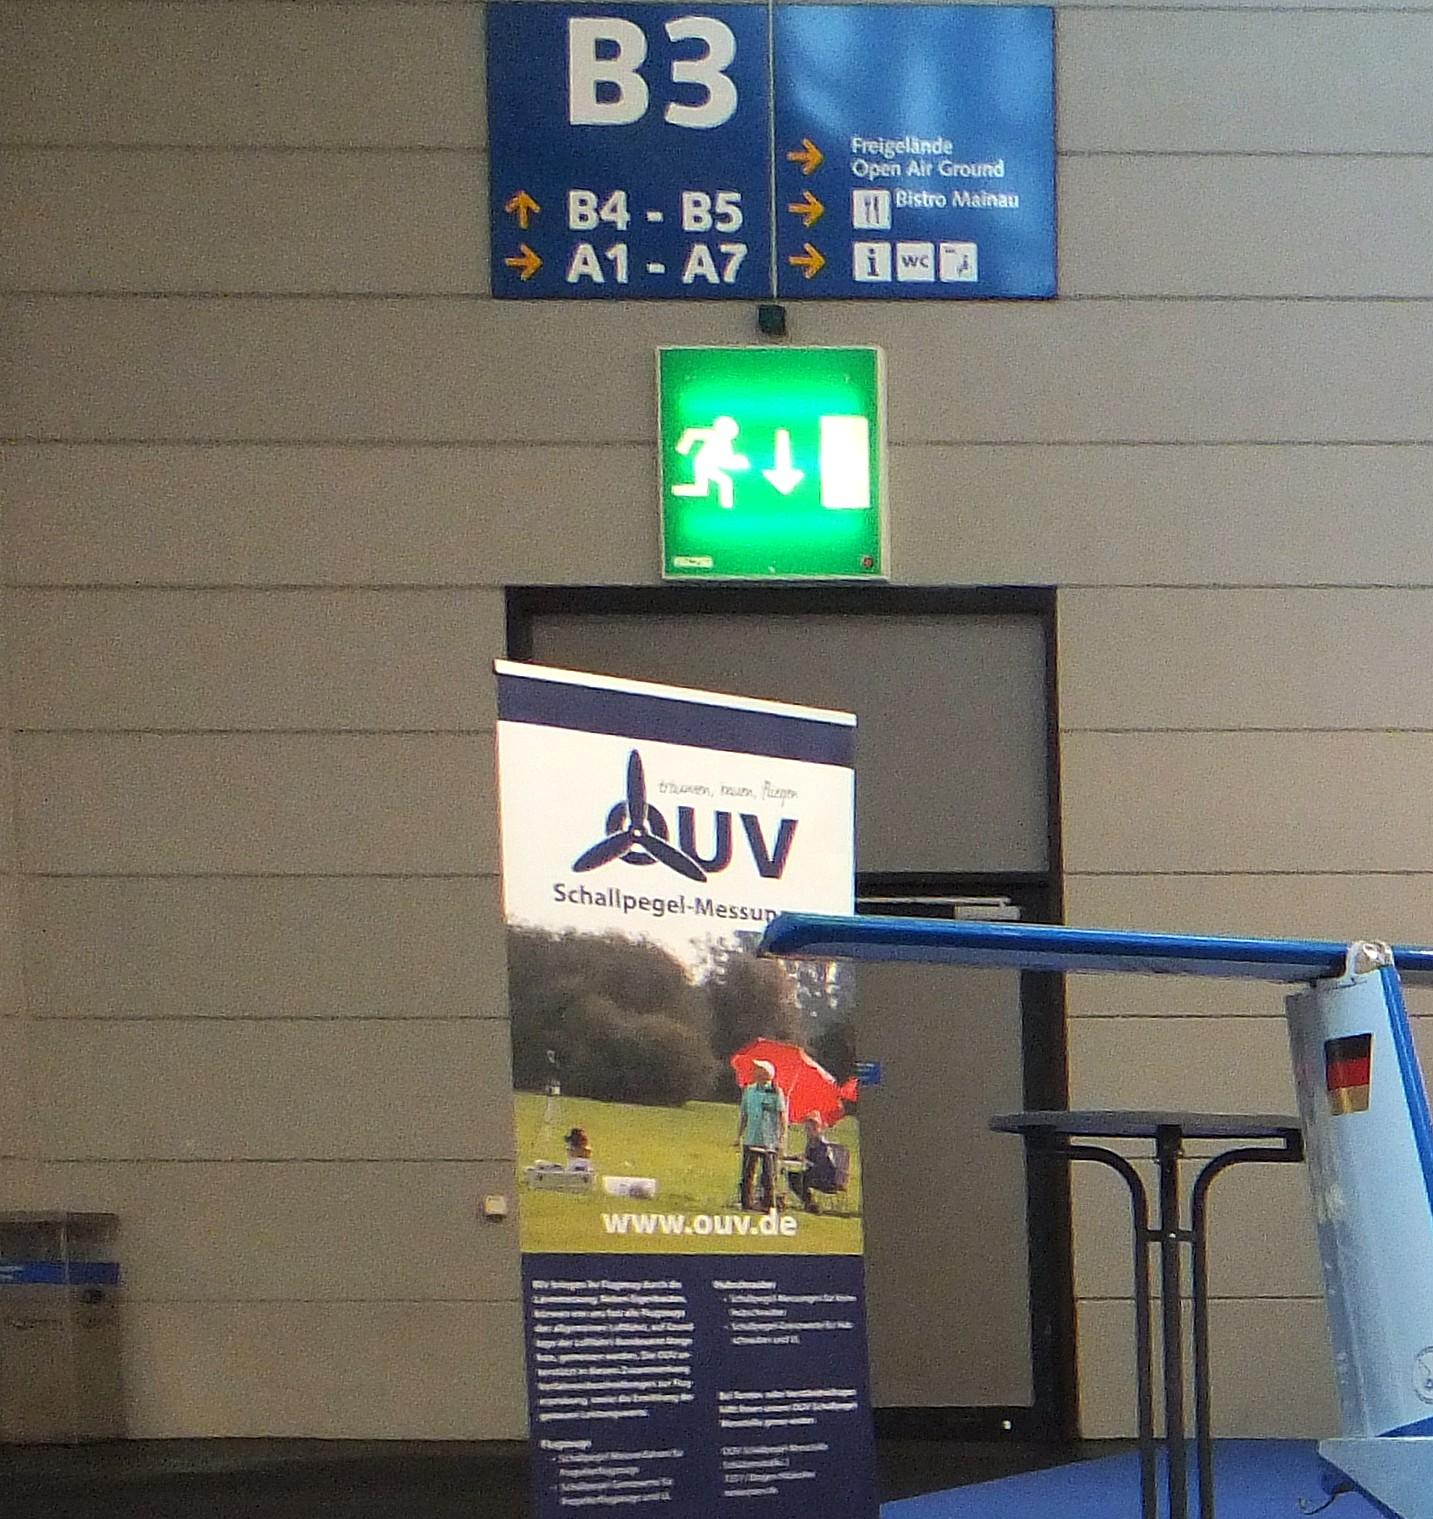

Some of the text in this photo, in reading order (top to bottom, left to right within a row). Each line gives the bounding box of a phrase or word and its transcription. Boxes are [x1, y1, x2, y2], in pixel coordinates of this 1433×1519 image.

[568, 16, 738, 129] B3
[852, 136, 953, 159] Freigelände
[852, 159, 1005, 181] Open Air Ground
[567, 190, 631, 231] B4
[681, 191, 744, 232] B5
[896, 188, 1020, 209] Bistro Mainau
[566, 243, 630, 285] A1
[682, 243, 749, 285] A7
[901, 254, 929, 269] WC
[553, 883, 778, 923] Schallpegel-Messun
[602, 1208, 798, 1237] www.ouv.de
